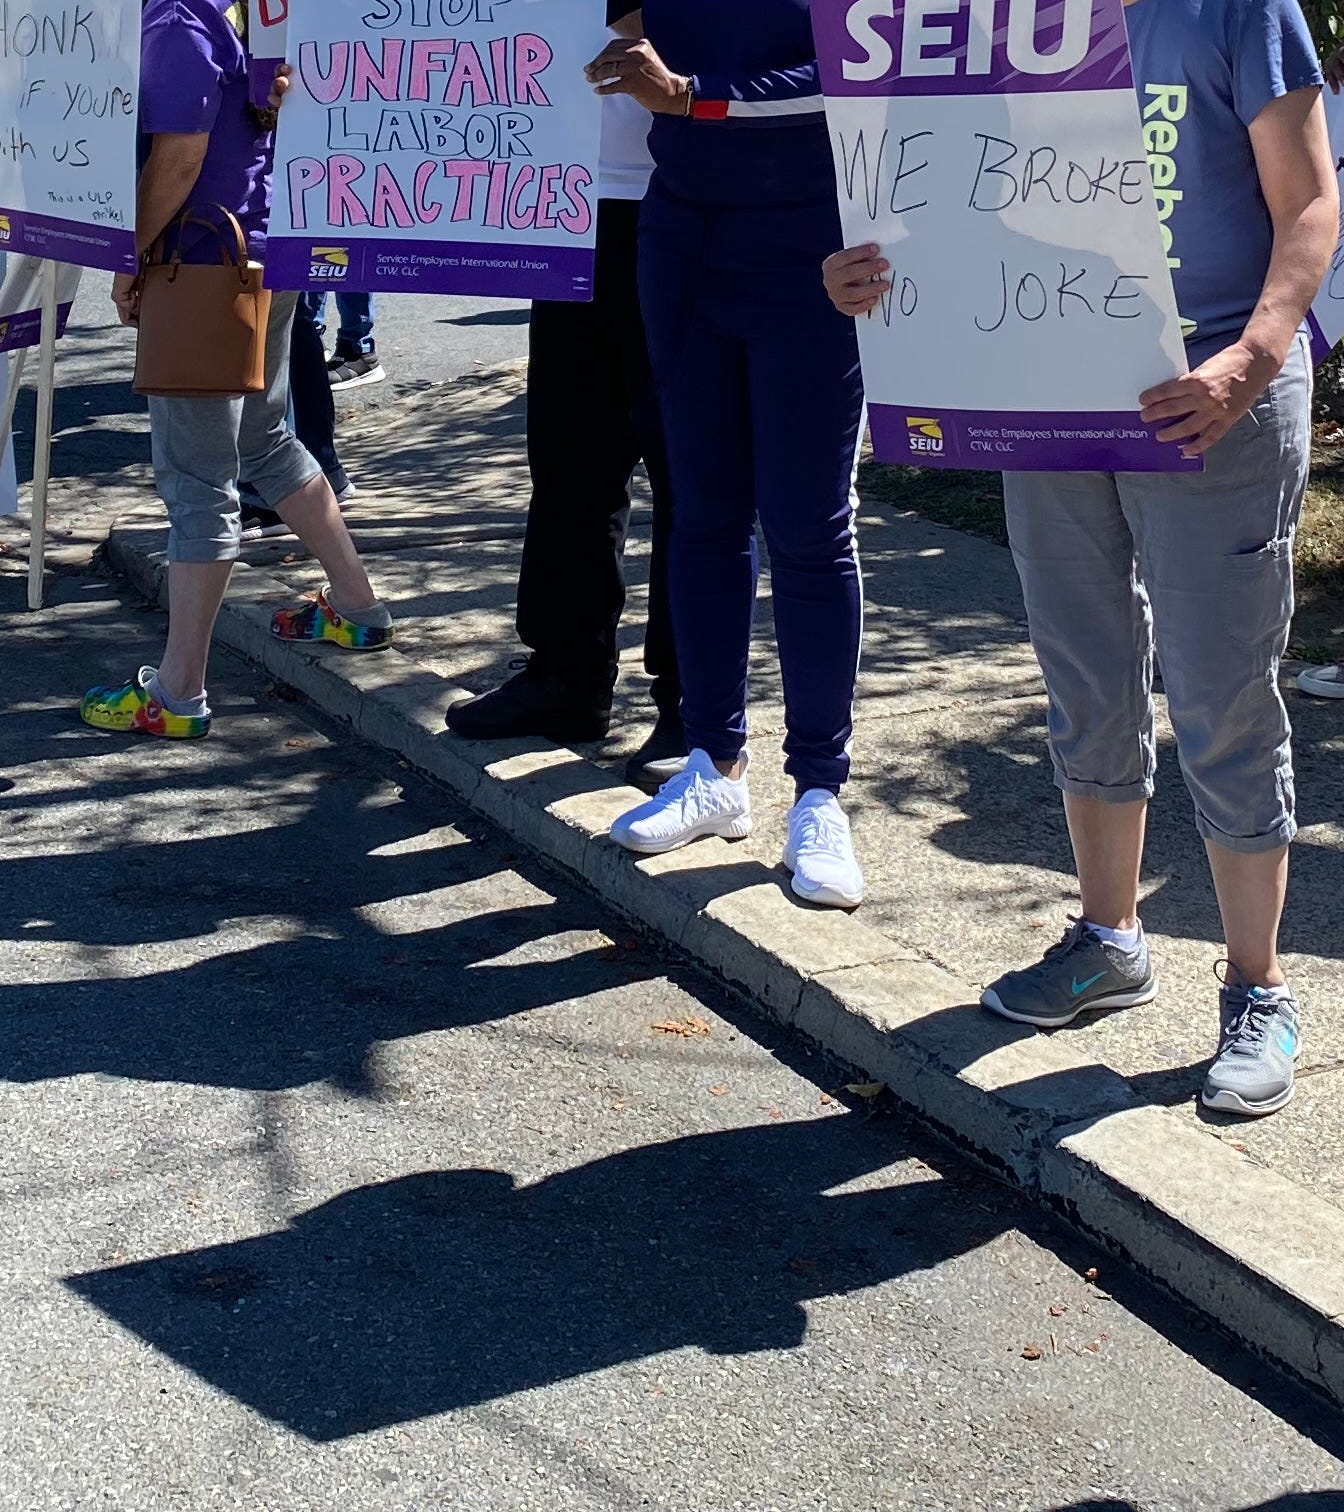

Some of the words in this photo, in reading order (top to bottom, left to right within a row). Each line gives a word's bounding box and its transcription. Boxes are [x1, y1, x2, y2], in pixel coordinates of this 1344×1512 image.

[299, 33, 553, 108] UNFAIR
[327, 106, 533, 160] LABOR
[839, 129, 933, 220] WE
[968, 133, 1146, 211] BROKE
[287, 154, 592, 234] PRACTICES
[376, 254, 408, 264] Service
[411, 255, 459, 268] Employees
[461, 257, 518, 269] International
[520, 260, 549, 270] Union
[308, 265, 348, 277] SEIU
[402, 267, 420, 276] CLC
[975, 261, 1149, 332] JOKE
[968, 427, 999, 438] Service
[1001, 428, 1051, 441] Employees
[1053, 429, 1114, 439] International
[1118, 429, 1148, 439] Union
[909, 438, 943, 451] SEIU
[995, 442, 1014, 452] CLC
